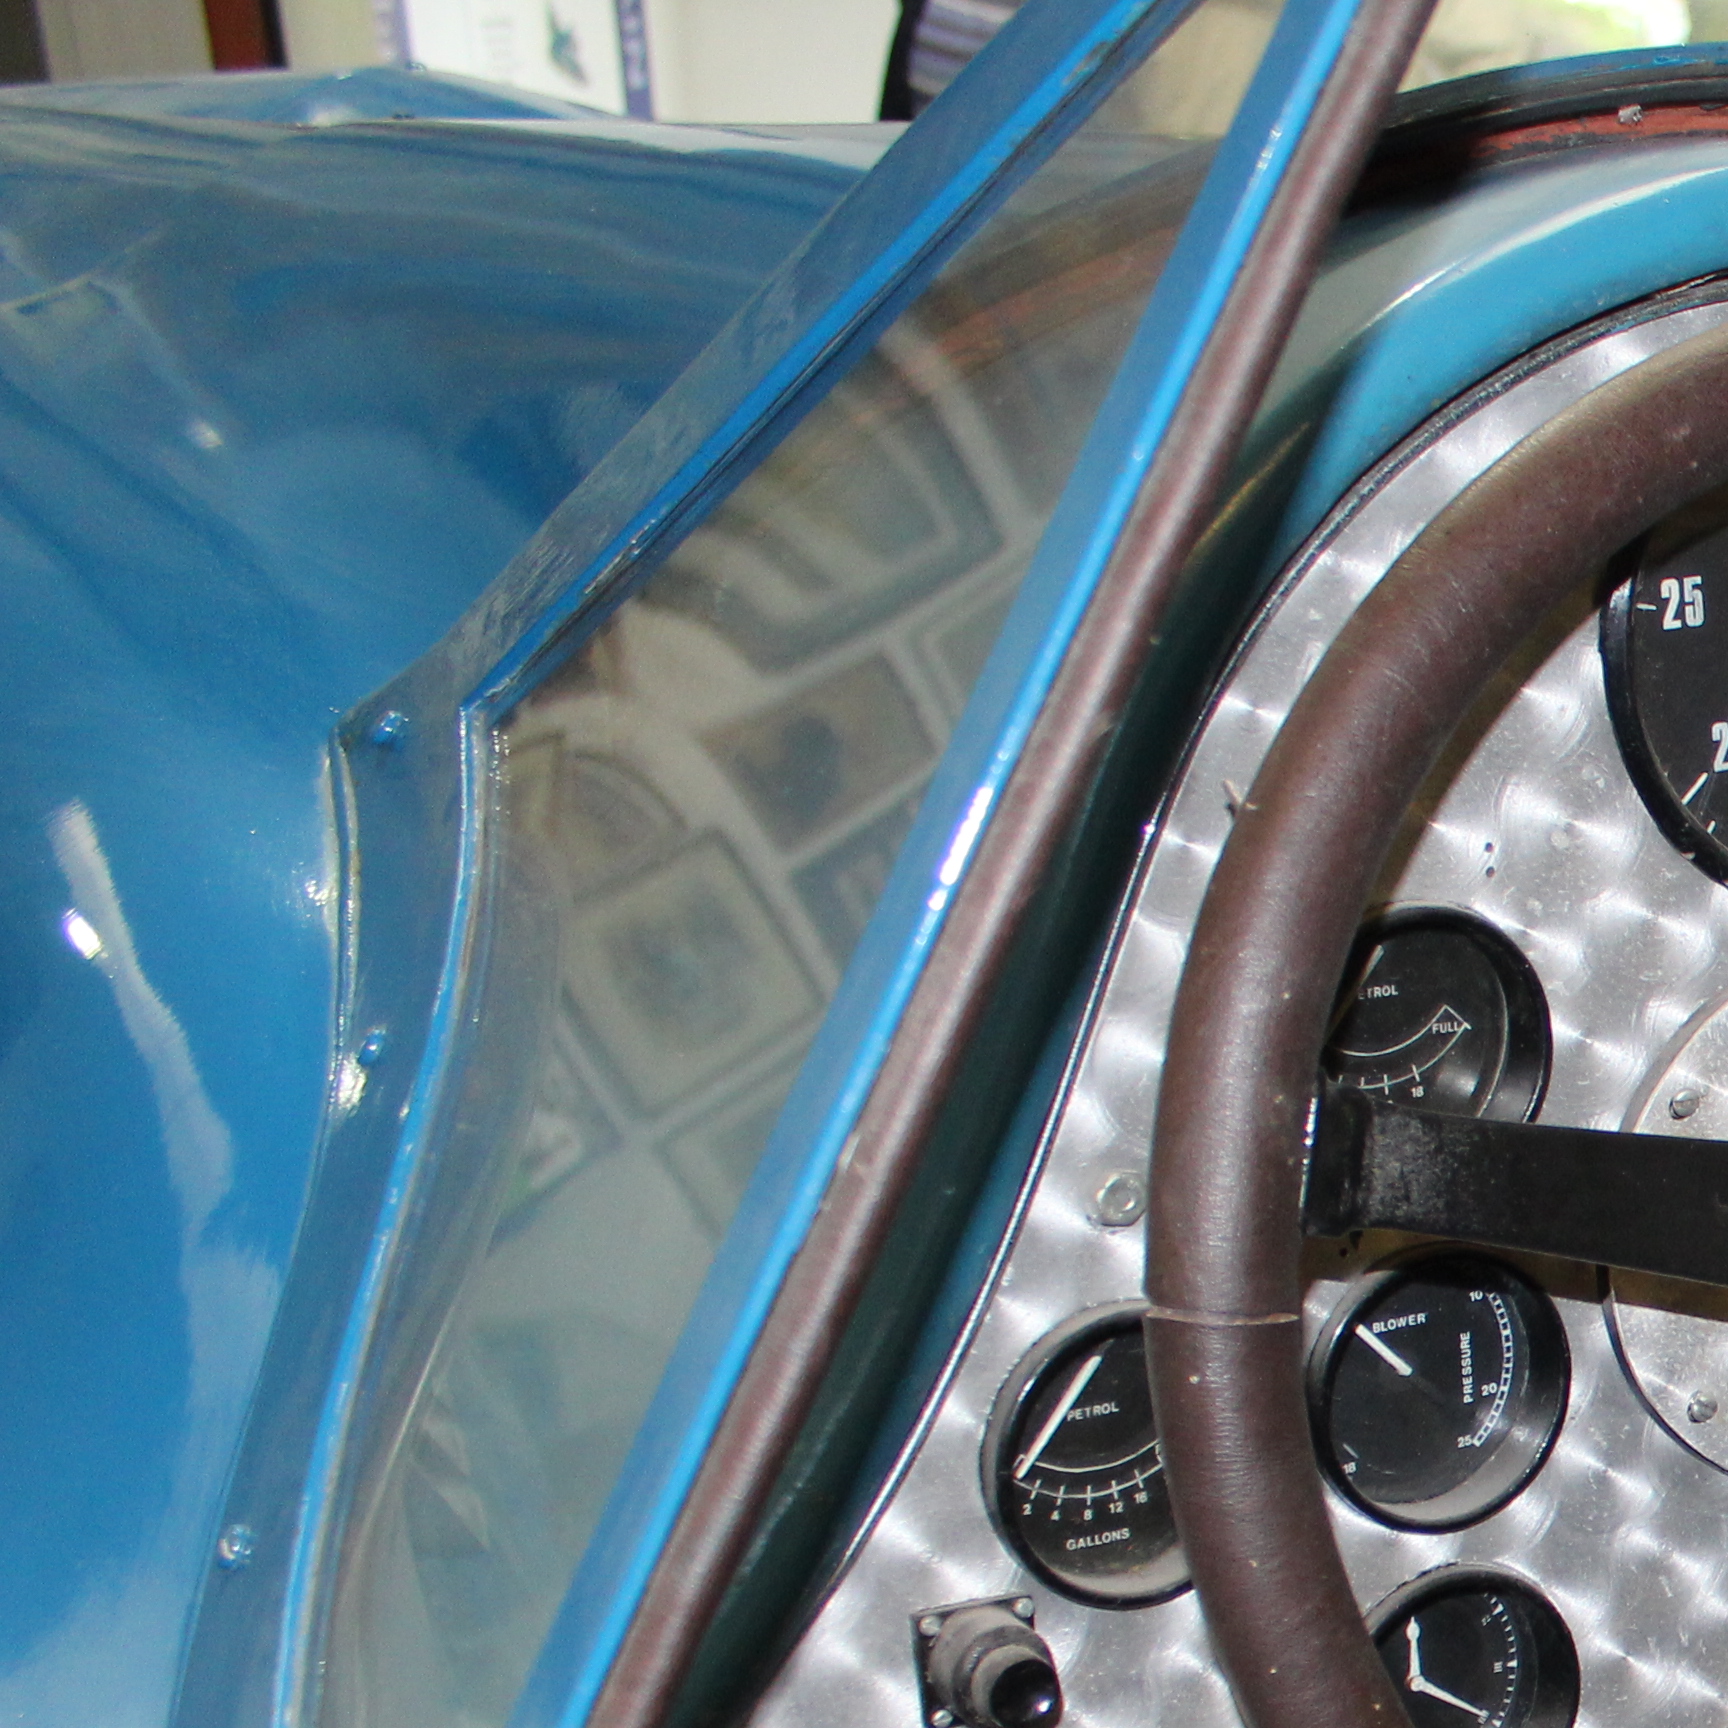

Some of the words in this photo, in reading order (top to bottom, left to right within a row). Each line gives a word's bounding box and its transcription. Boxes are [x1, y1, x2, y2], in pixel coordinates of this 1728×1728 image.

[1660, 575, 1705, 630] 25
[1432, 1021, 1461, 1035] FULL
[1411, 1086, 1425, 1098] 18
[1468, 1290, 1484, 1302] 10
[1372, 1312, 1428, 1334] BLOWER
[1459, 1331, 1474, 1404] PRESSURE
[1480, 1382, 1498, 1397] 20
[1066, 1402, 1120, 1422] PETROL
[1457, 1435, 1473, 1449] 25
[1022, 1503, 1032, 1516] 2
[1050, 1509, 1061, 1521] 4
[1083, 1508, 1093, 1521] 8
[1109, 1501, 1125, 1514] 12
[1133, 1491, 1148, 1504] 16
[1065, 1528, 1131, 1551] GALLONS
